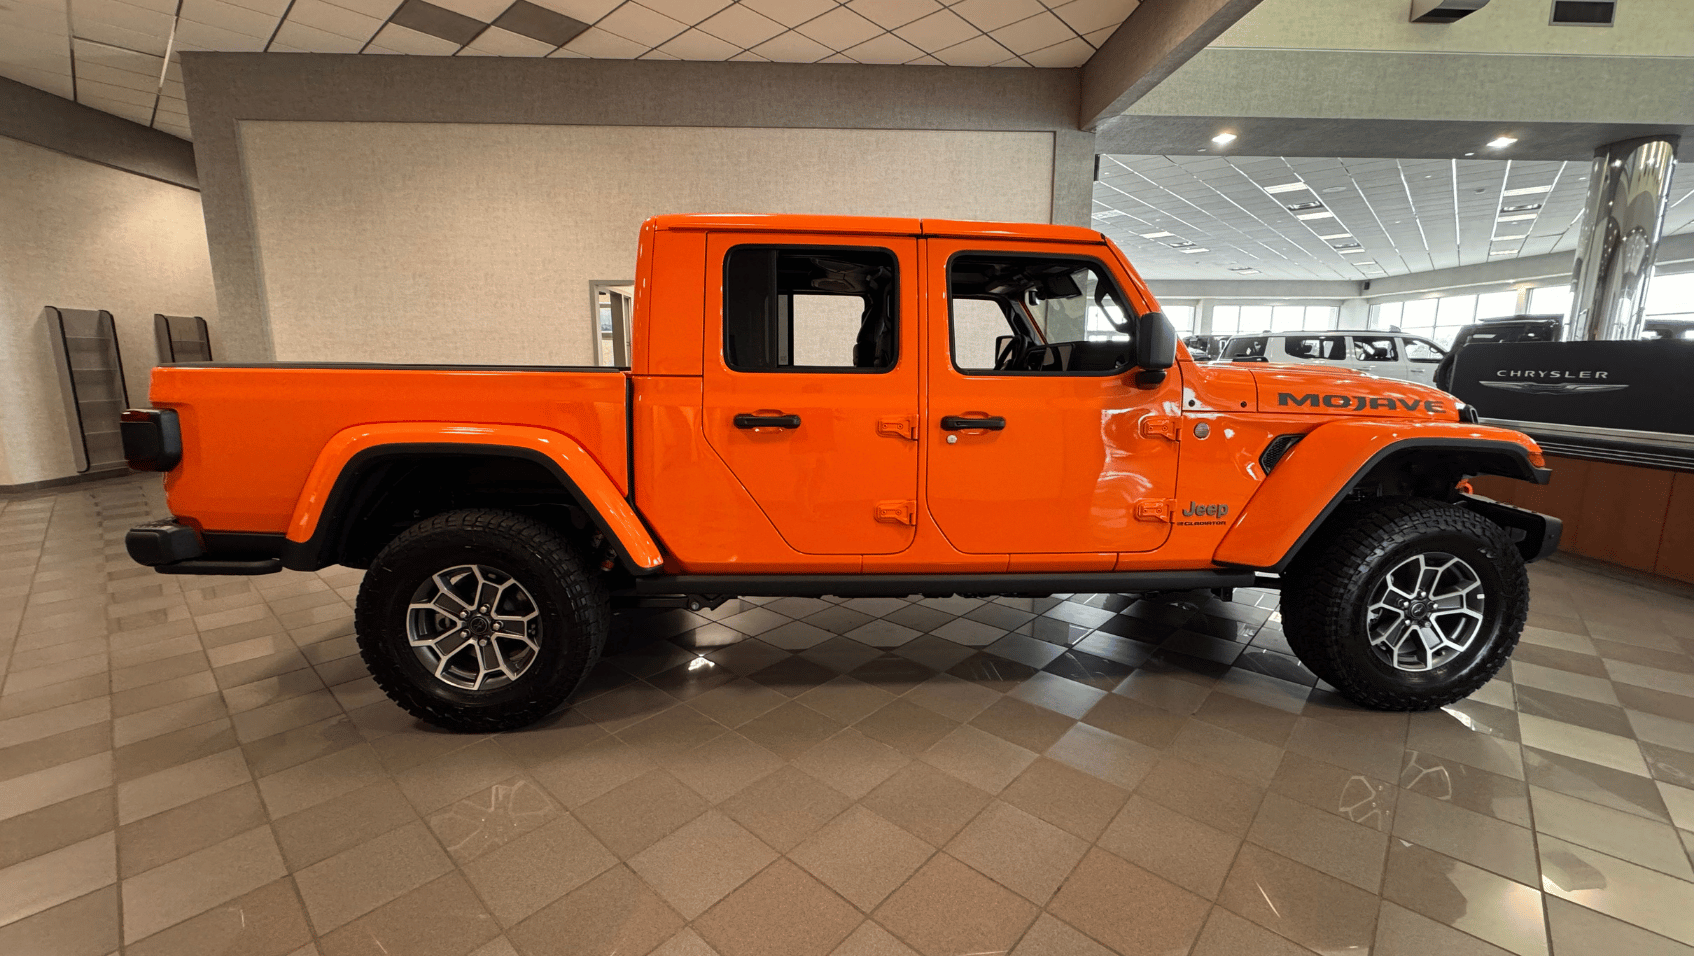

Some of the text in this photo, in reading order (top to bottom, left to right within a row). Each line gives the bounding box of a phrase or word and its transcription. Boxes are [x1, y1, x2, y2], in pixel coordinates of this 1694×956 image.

[1496, 369, 1609, 379] CHRYSLER
[1277, 392, 1447, 414] MOJAVE
[1182, 500, 1229, 519] Jeep
